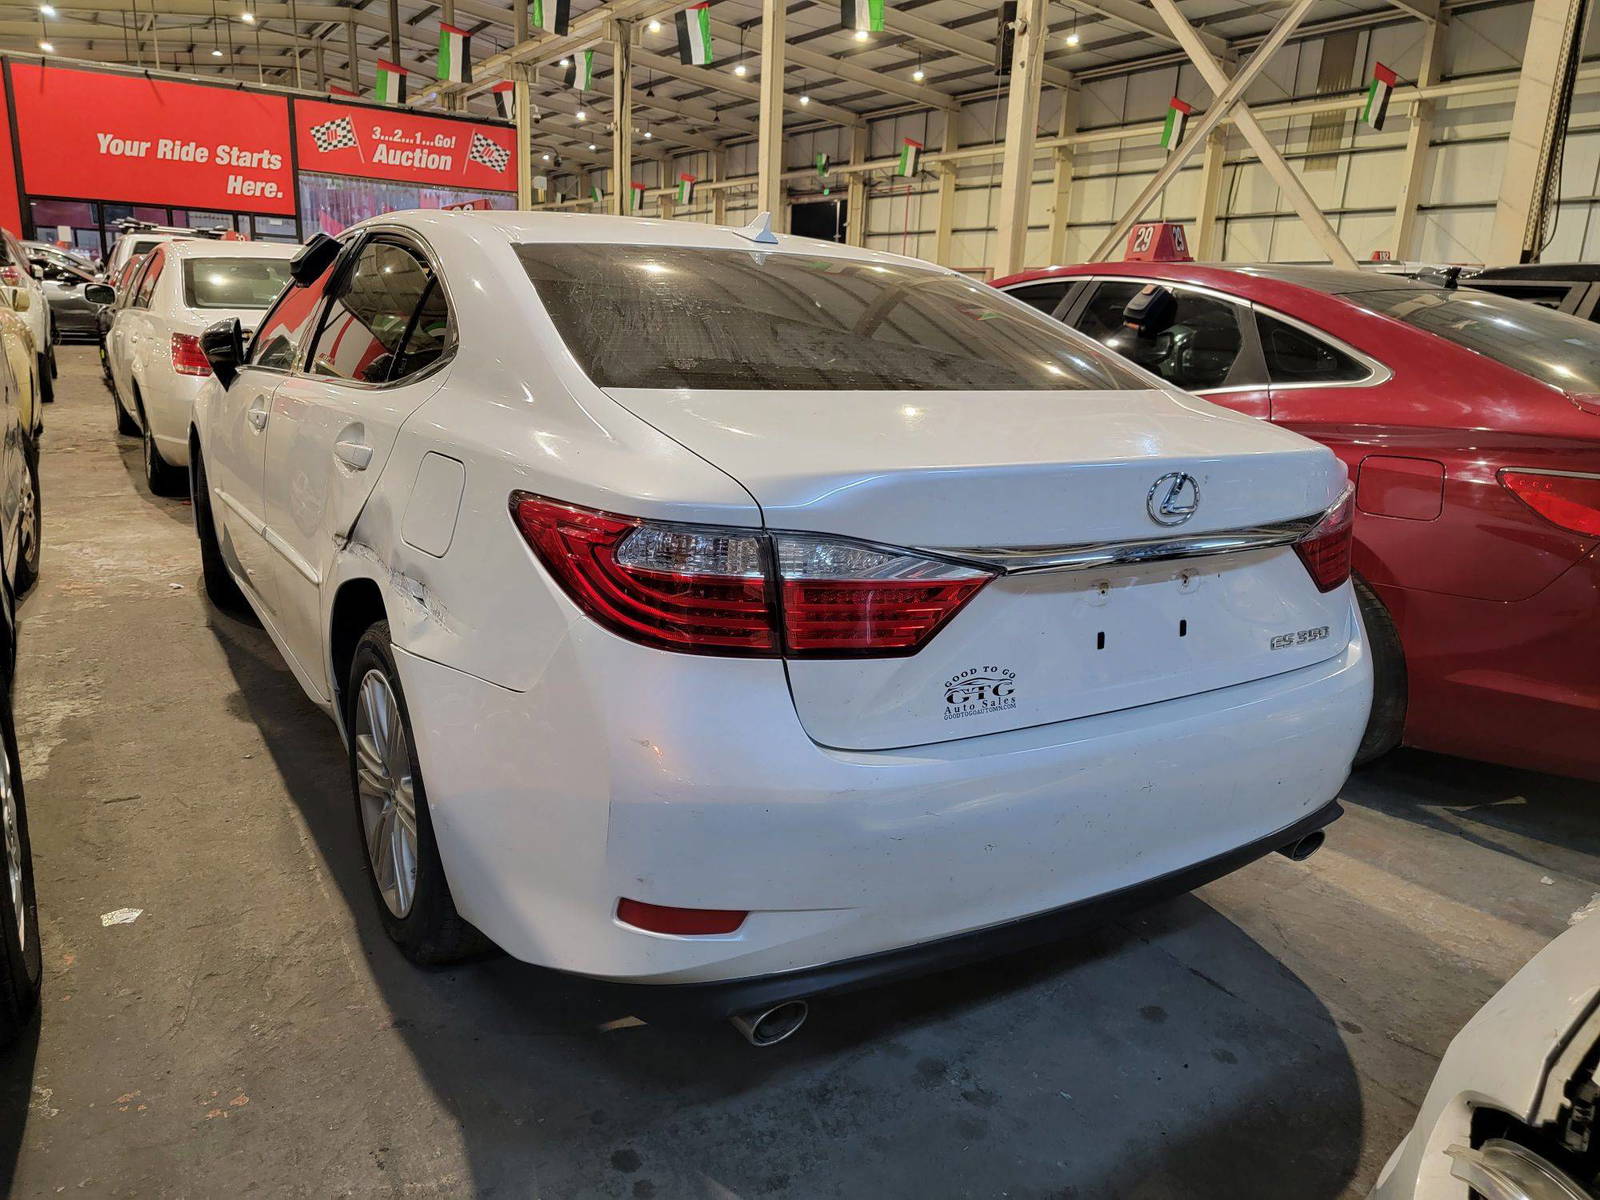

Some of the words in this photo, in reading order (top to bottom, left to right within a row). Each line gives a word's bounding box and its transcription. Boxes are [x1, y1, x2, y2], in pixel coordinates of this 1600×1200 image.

[371, 126, 456, 149] 3...2...1...Go!
[97, 133, 151, 157] Your
[157, 138, 209, 163] Ride
[215, 144, 282, 170] Starts
[372, 143, 453, 171] Auction
[226, 175, 283, 199] Here.
[1133, 226, 1154, 252] 29
[1270, 633, 1295, 651] ES
[1297, 625, 1330, 645] 350
[944, 668, 977, 688] GOOD
[982, 665, 998, 673] TO
[1002, 668, 1016, 679] GO
[946, 681, 1015, 704] GTG
[943, 704, 975, 715] Auto
[982, 696, 1016, 708] Sales
